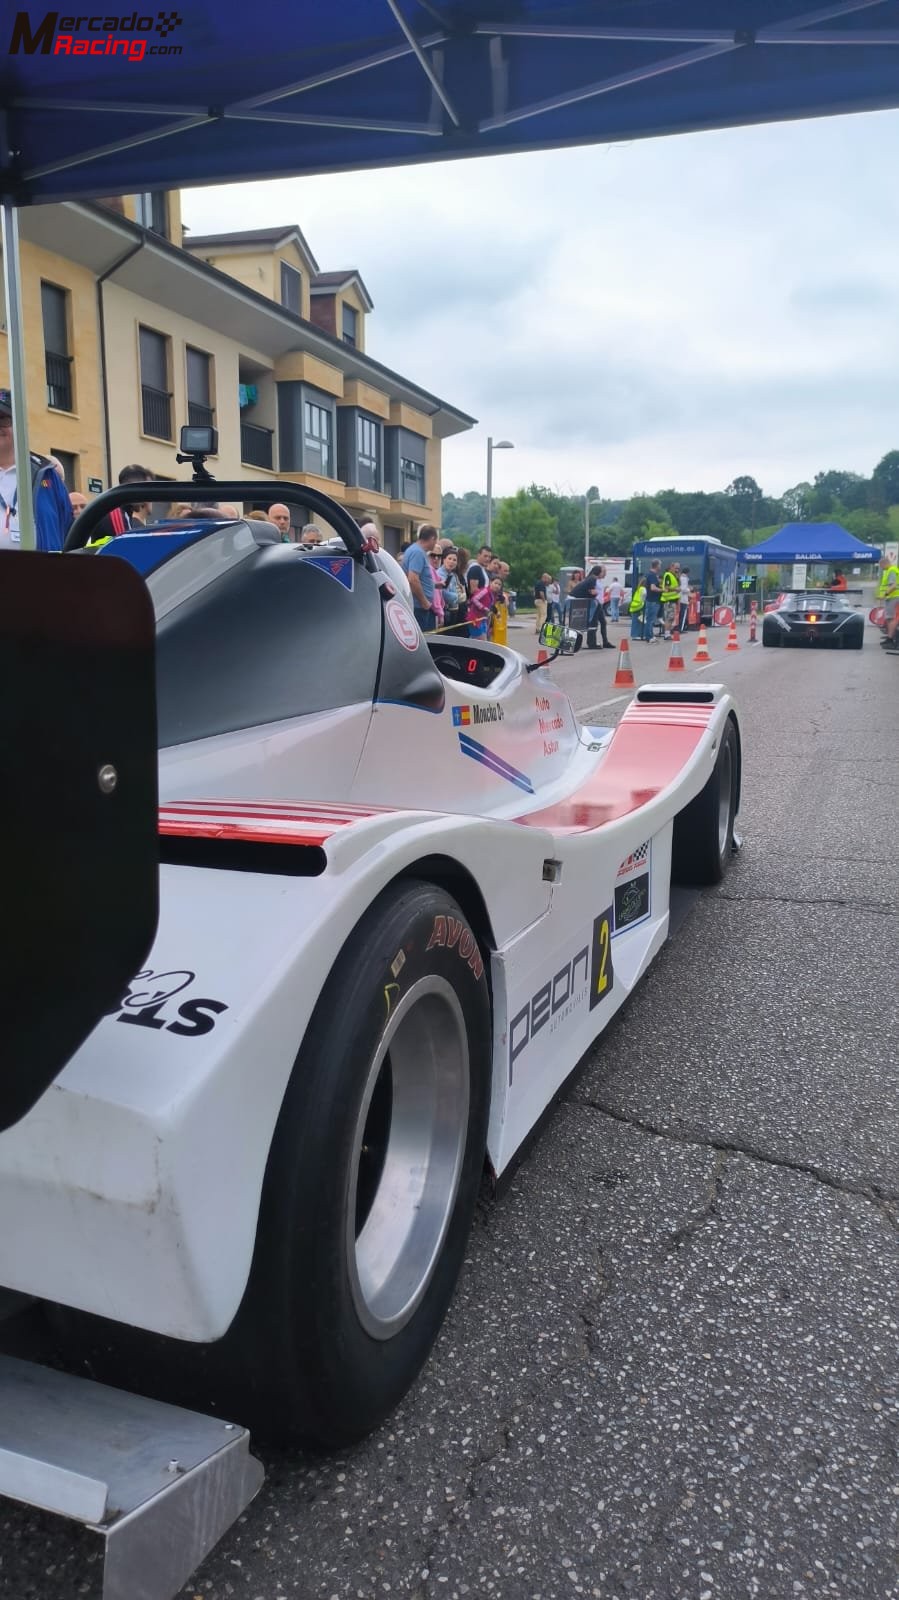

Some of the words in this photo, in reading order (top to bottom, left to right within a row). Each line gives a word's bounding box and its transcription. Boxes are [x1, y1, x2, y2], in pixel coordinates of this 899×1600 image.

[395, 610, 413, 636] E
[468, 660, 477, 672] 0
[597, 919, 611, 995] 2
